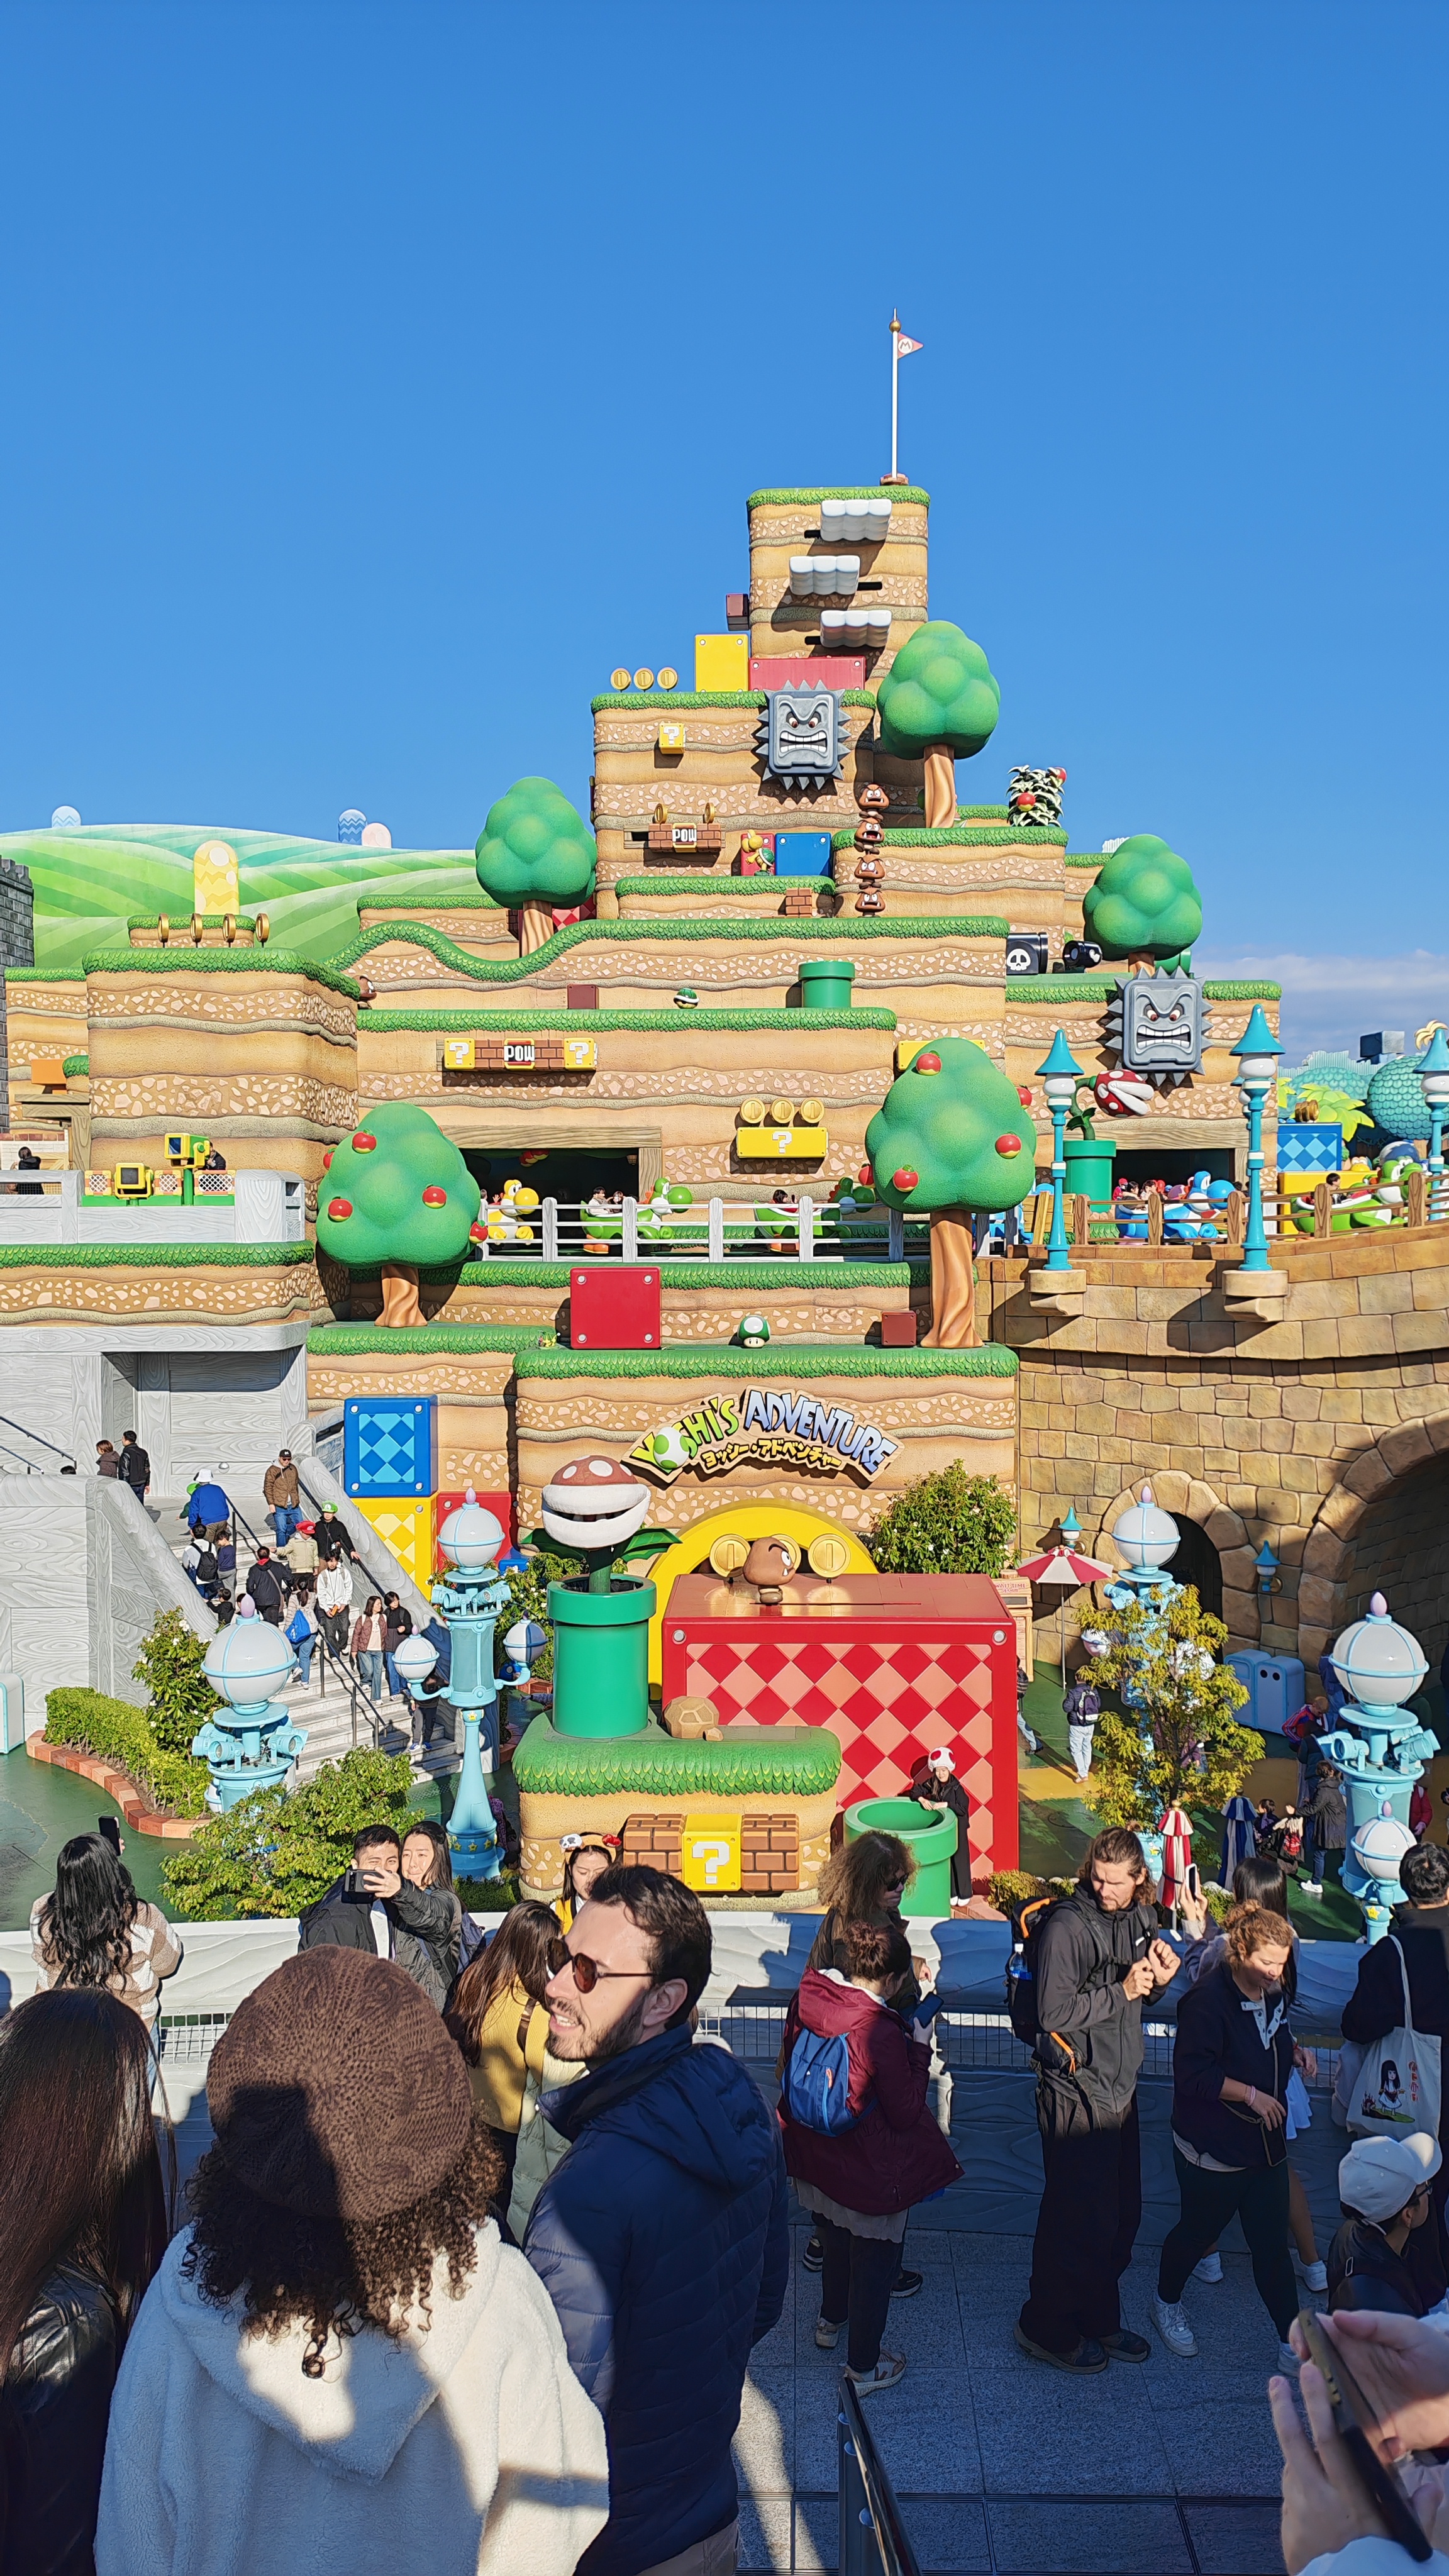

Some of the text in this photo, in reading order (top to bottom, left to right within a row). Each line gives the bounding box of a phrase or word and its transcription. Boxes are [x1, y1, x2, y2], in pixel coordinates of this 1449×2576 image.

[899, 341, 911, 350] M
[672, 828, 697, 842] POW
[504, 1045, 535, 1062] POW
[743, 1389, 898, 1474] ADVENTURE
[701, 1438, 842, 1468] ヨッシー・アドベンチャー
[692, 1841, 730, 1885] ?
